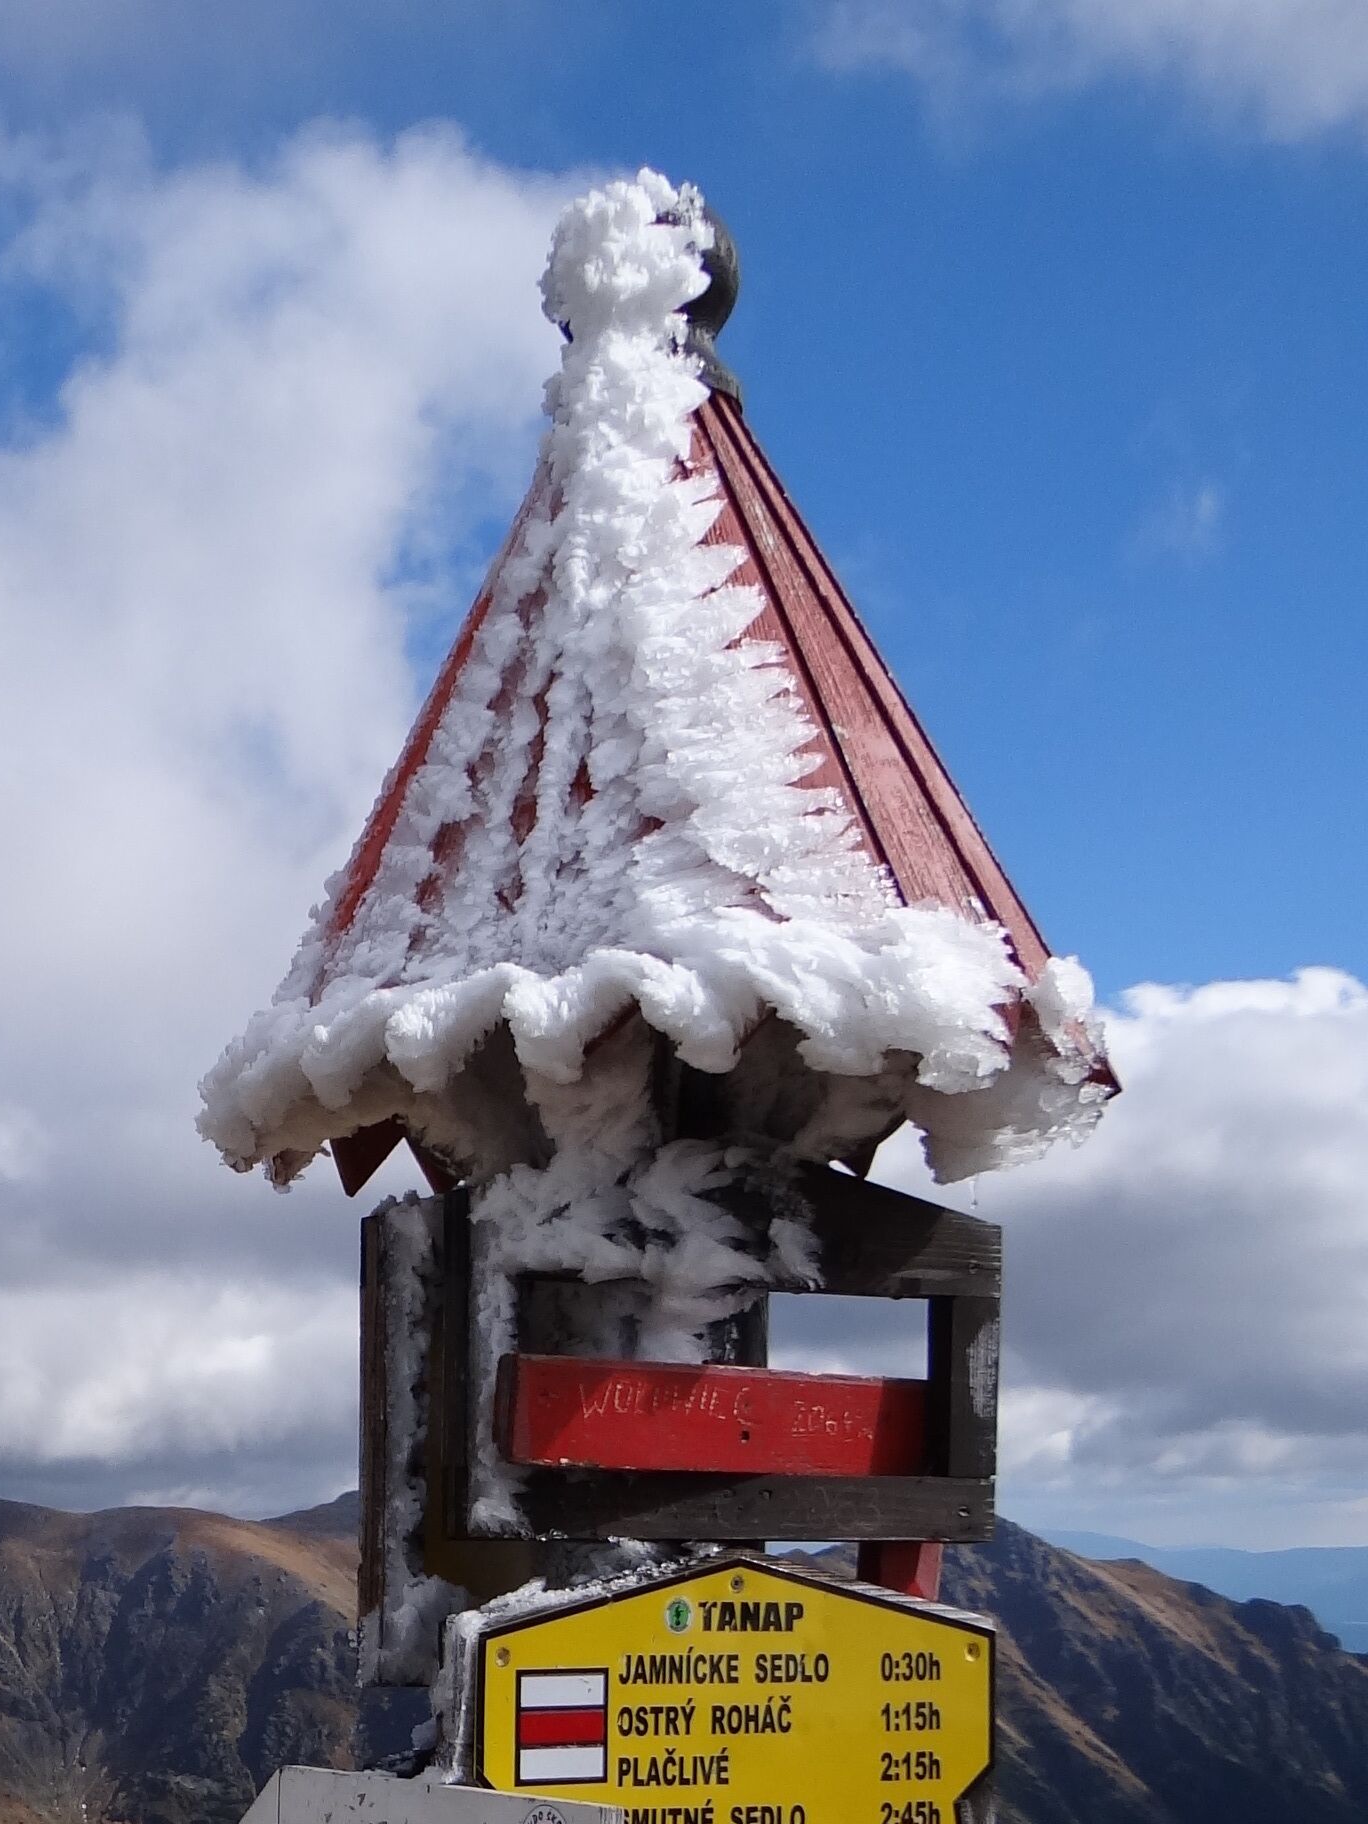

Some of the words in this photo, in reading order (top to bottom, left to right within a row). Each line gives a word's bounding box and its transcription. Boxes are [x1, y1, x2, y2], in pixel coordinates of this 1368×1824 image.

[699, 1600, 804, 1633] TANAP
[618, 1647, 739, 1686] JAMNÍCKE
[754, 1653, 830, 1684] SEDLO
[880, 1651, 941, 1682] 0:30h
[617, 1697, 696, 1737] OSTRÝ
[711, 1695, 792, 1735] ROHÁČ
[880, 1701, 941, 1732] 1:15h
[617, 1747, 730, 1788] PLAČLIVÉ
[880, 1750, 941, 1782] 2:15h
